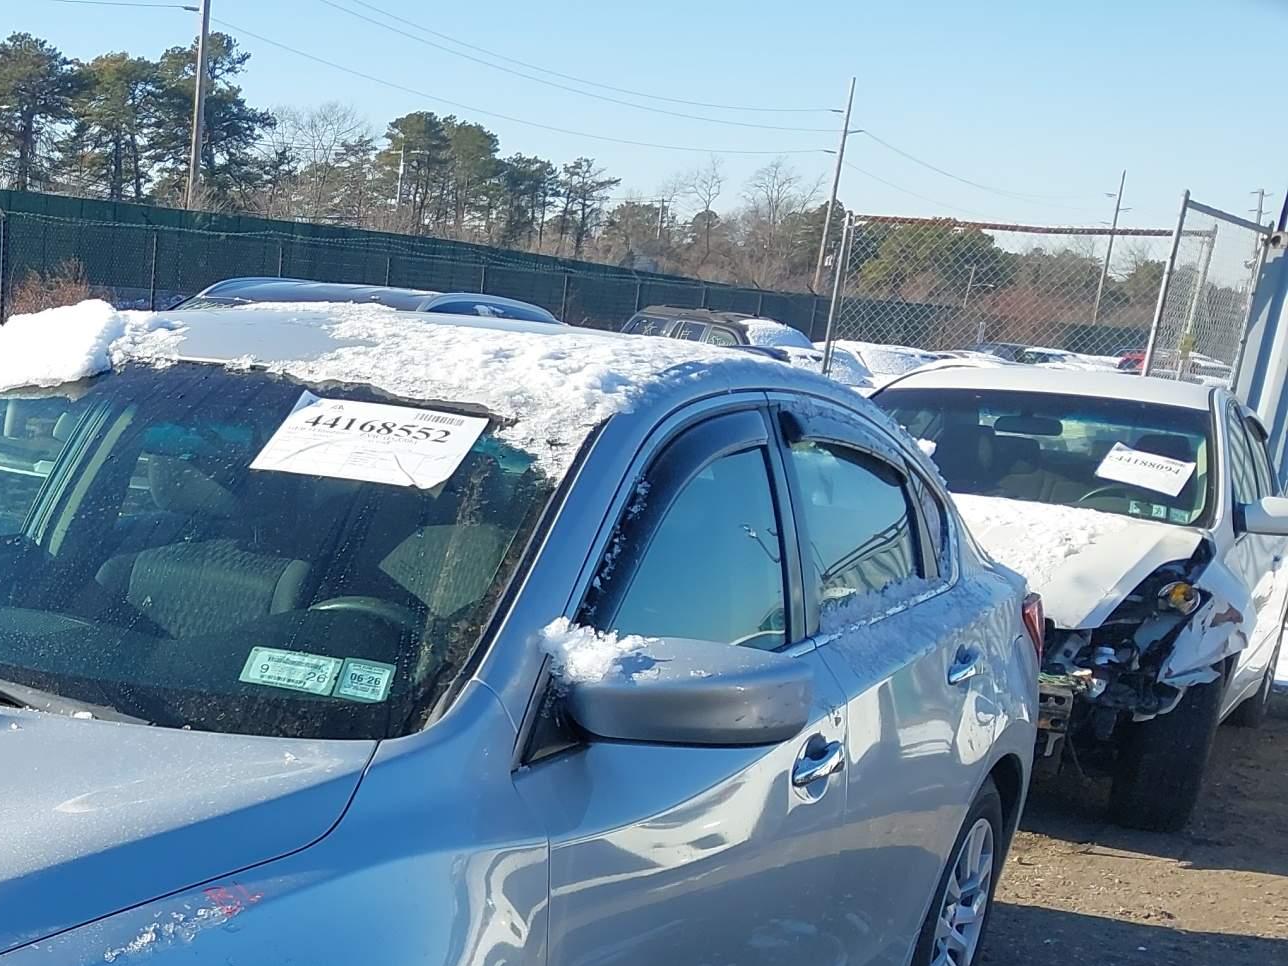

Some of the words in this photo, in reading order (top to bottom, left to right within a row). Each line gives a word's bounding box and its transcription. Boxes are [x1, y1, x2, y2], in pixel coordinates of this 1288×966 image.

[304, 414, 452, 444] 44168552
[260, 663, 270, 674] 9
[305, 671, 327, 684] 26
